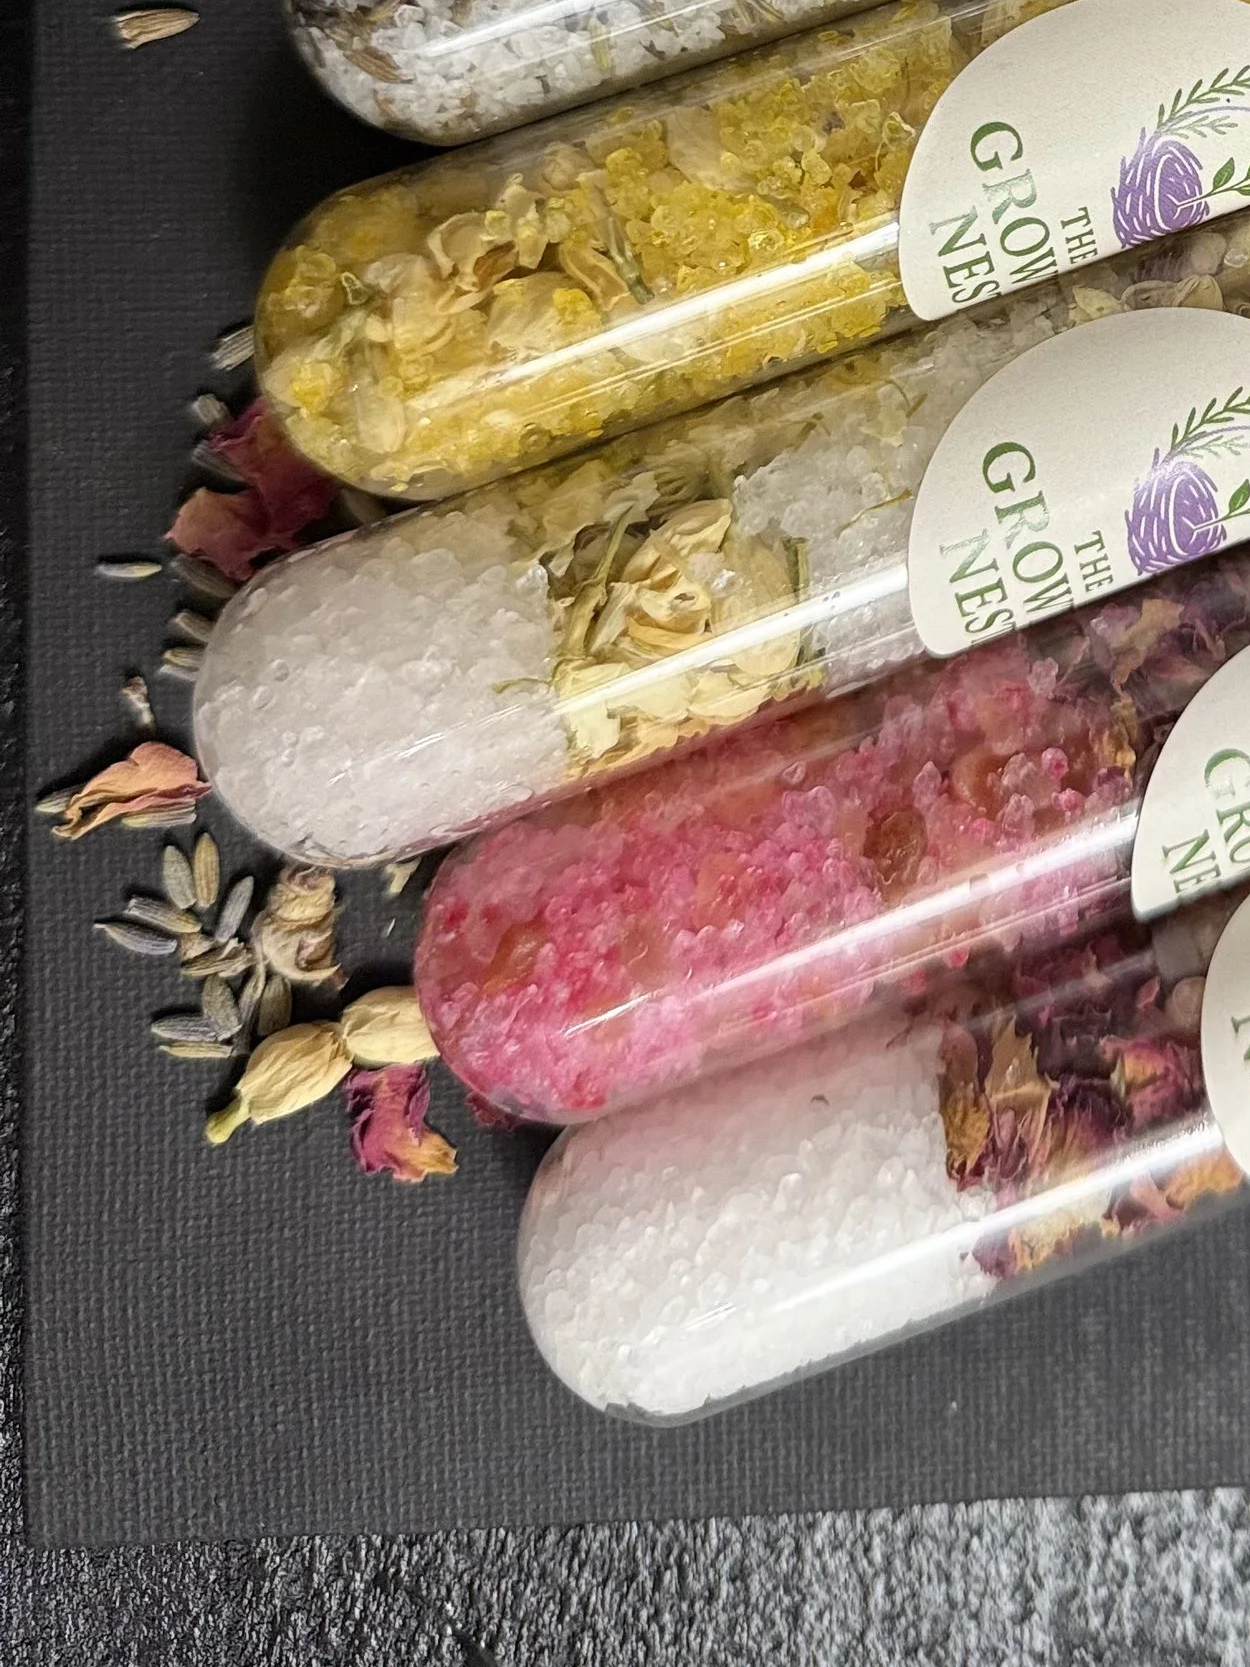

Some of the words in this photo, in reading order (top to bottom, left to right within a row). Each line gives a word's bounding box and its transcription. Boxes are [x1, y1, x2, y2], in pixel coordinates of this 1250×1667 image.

[928, 204, 1002, 305] NES
[1060, 205, 1099, 265] THE
[982, 441, 1076, 614] GROW
[1074, 529, 1114, 593] THE
